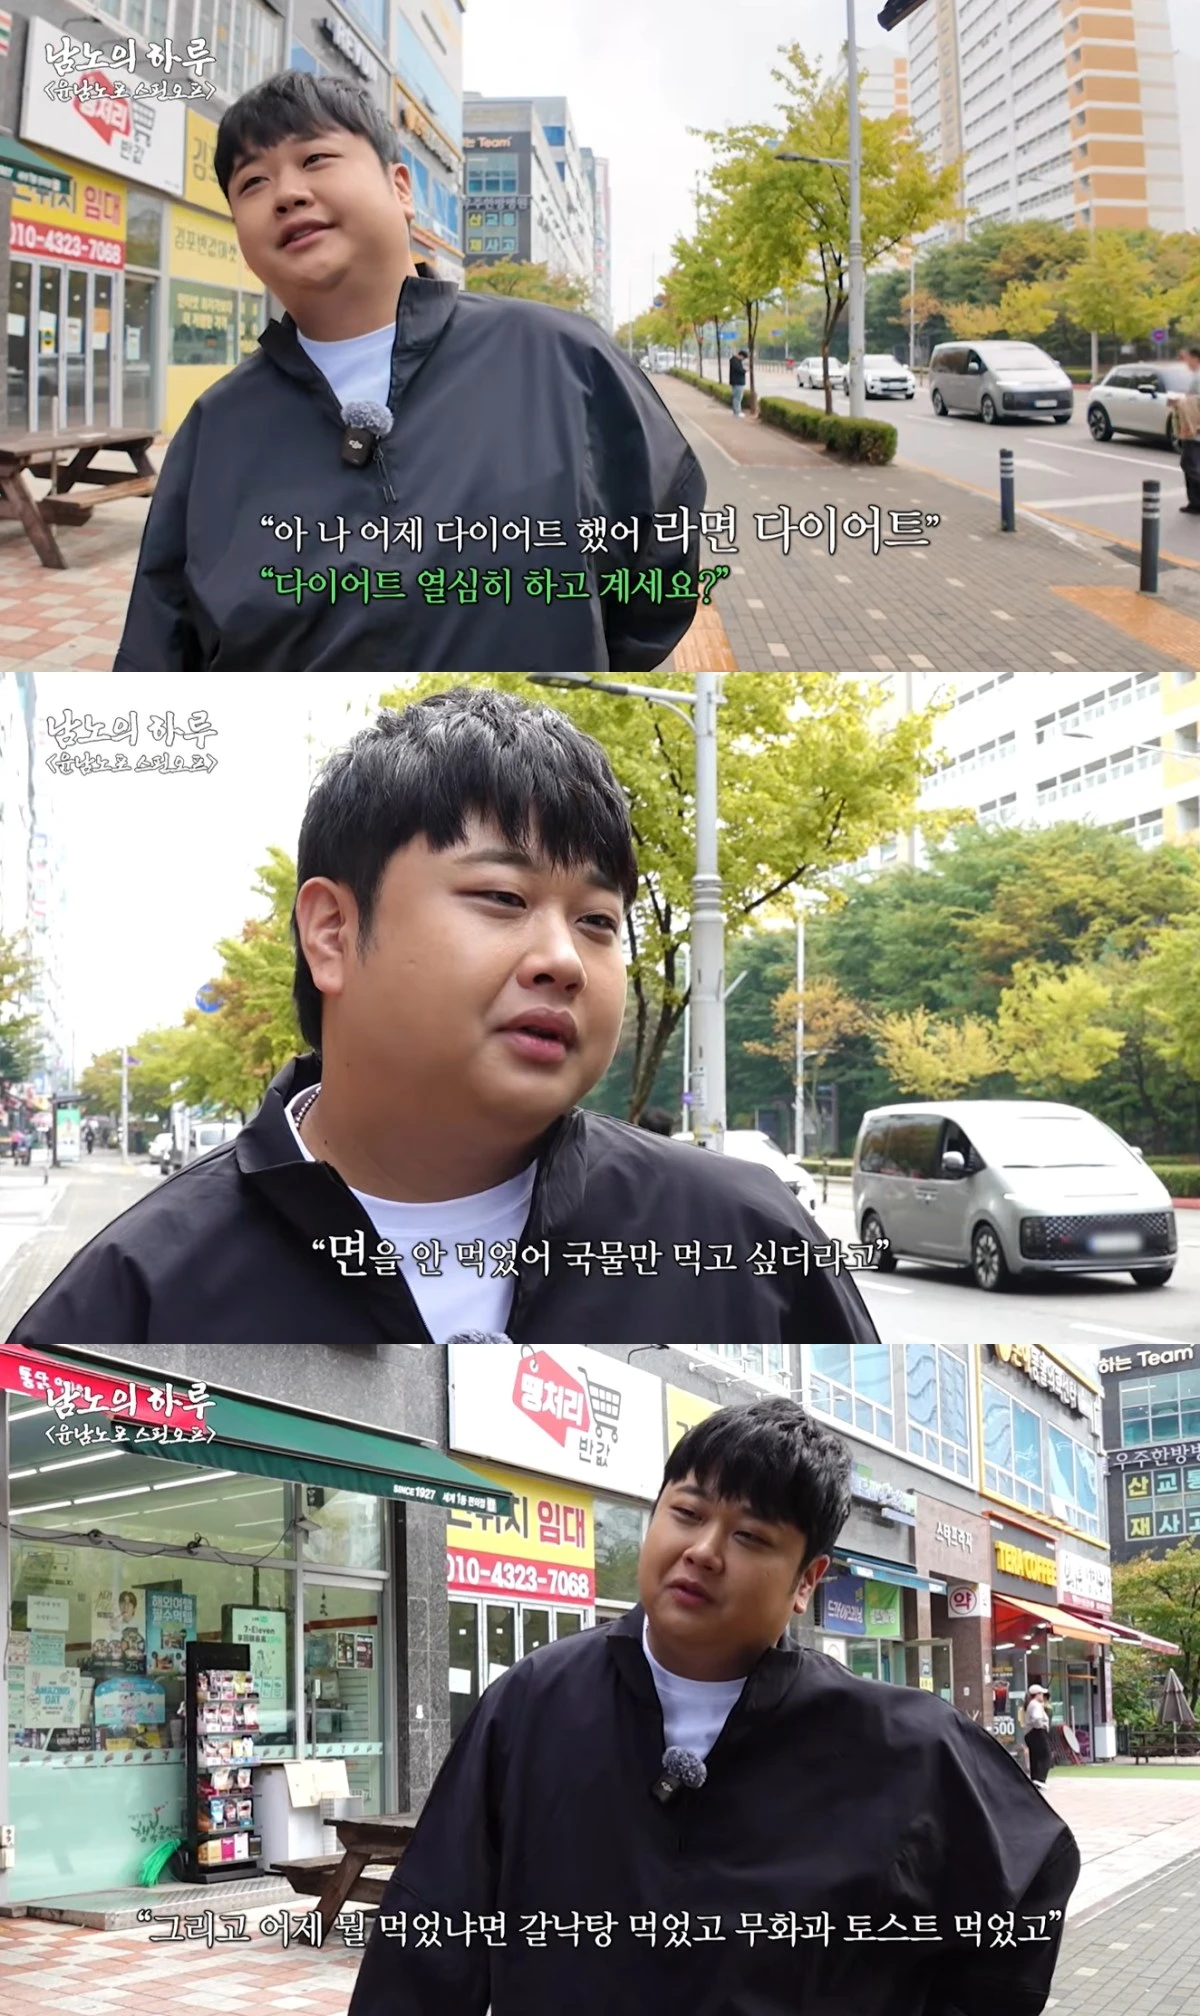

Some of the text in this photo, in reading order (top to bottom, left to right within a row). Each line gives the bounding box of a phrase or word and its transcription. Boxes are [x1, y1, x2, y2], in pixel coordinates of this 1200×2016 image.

[579, 1435, 611, 1468] 반값
[537, 1500, 585, 1548] 임대
[935, 1521, 973, 1553] 스타프라자
[953, 1591, 972, 1611] 약
